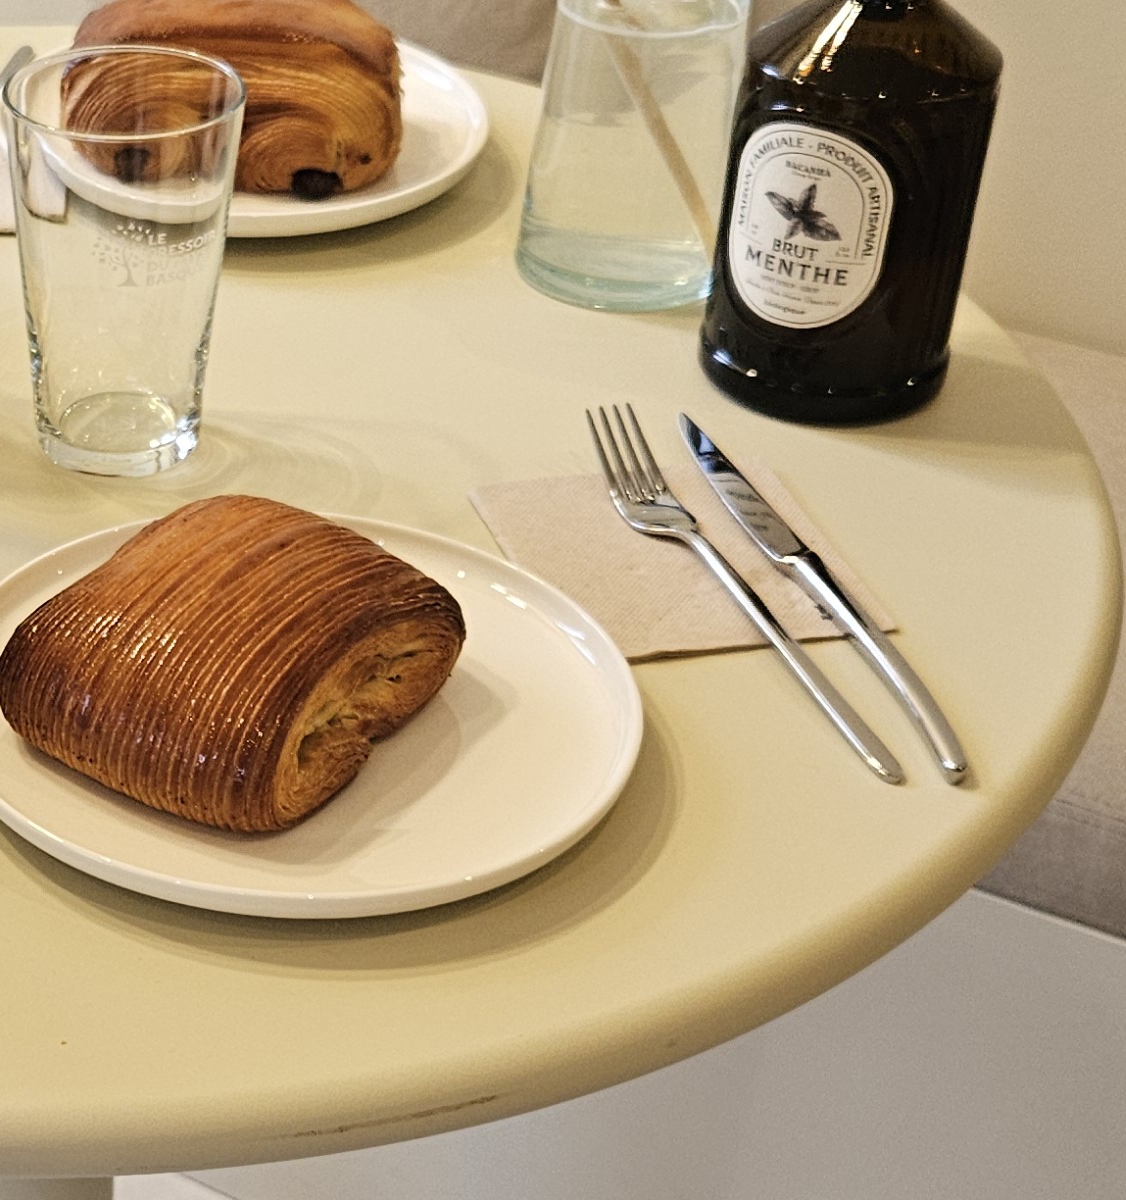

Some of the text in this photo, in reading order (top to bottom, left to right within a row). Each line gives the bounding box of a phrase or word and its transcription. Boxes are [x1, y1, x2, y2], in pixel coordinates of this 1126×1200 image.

[817, 142, 874, 183] PRODUIT
[148, 233, 168, 246] LE
[772, 238, 819, 260] BRUT
[745, 244, 849, 286] MENTHE
